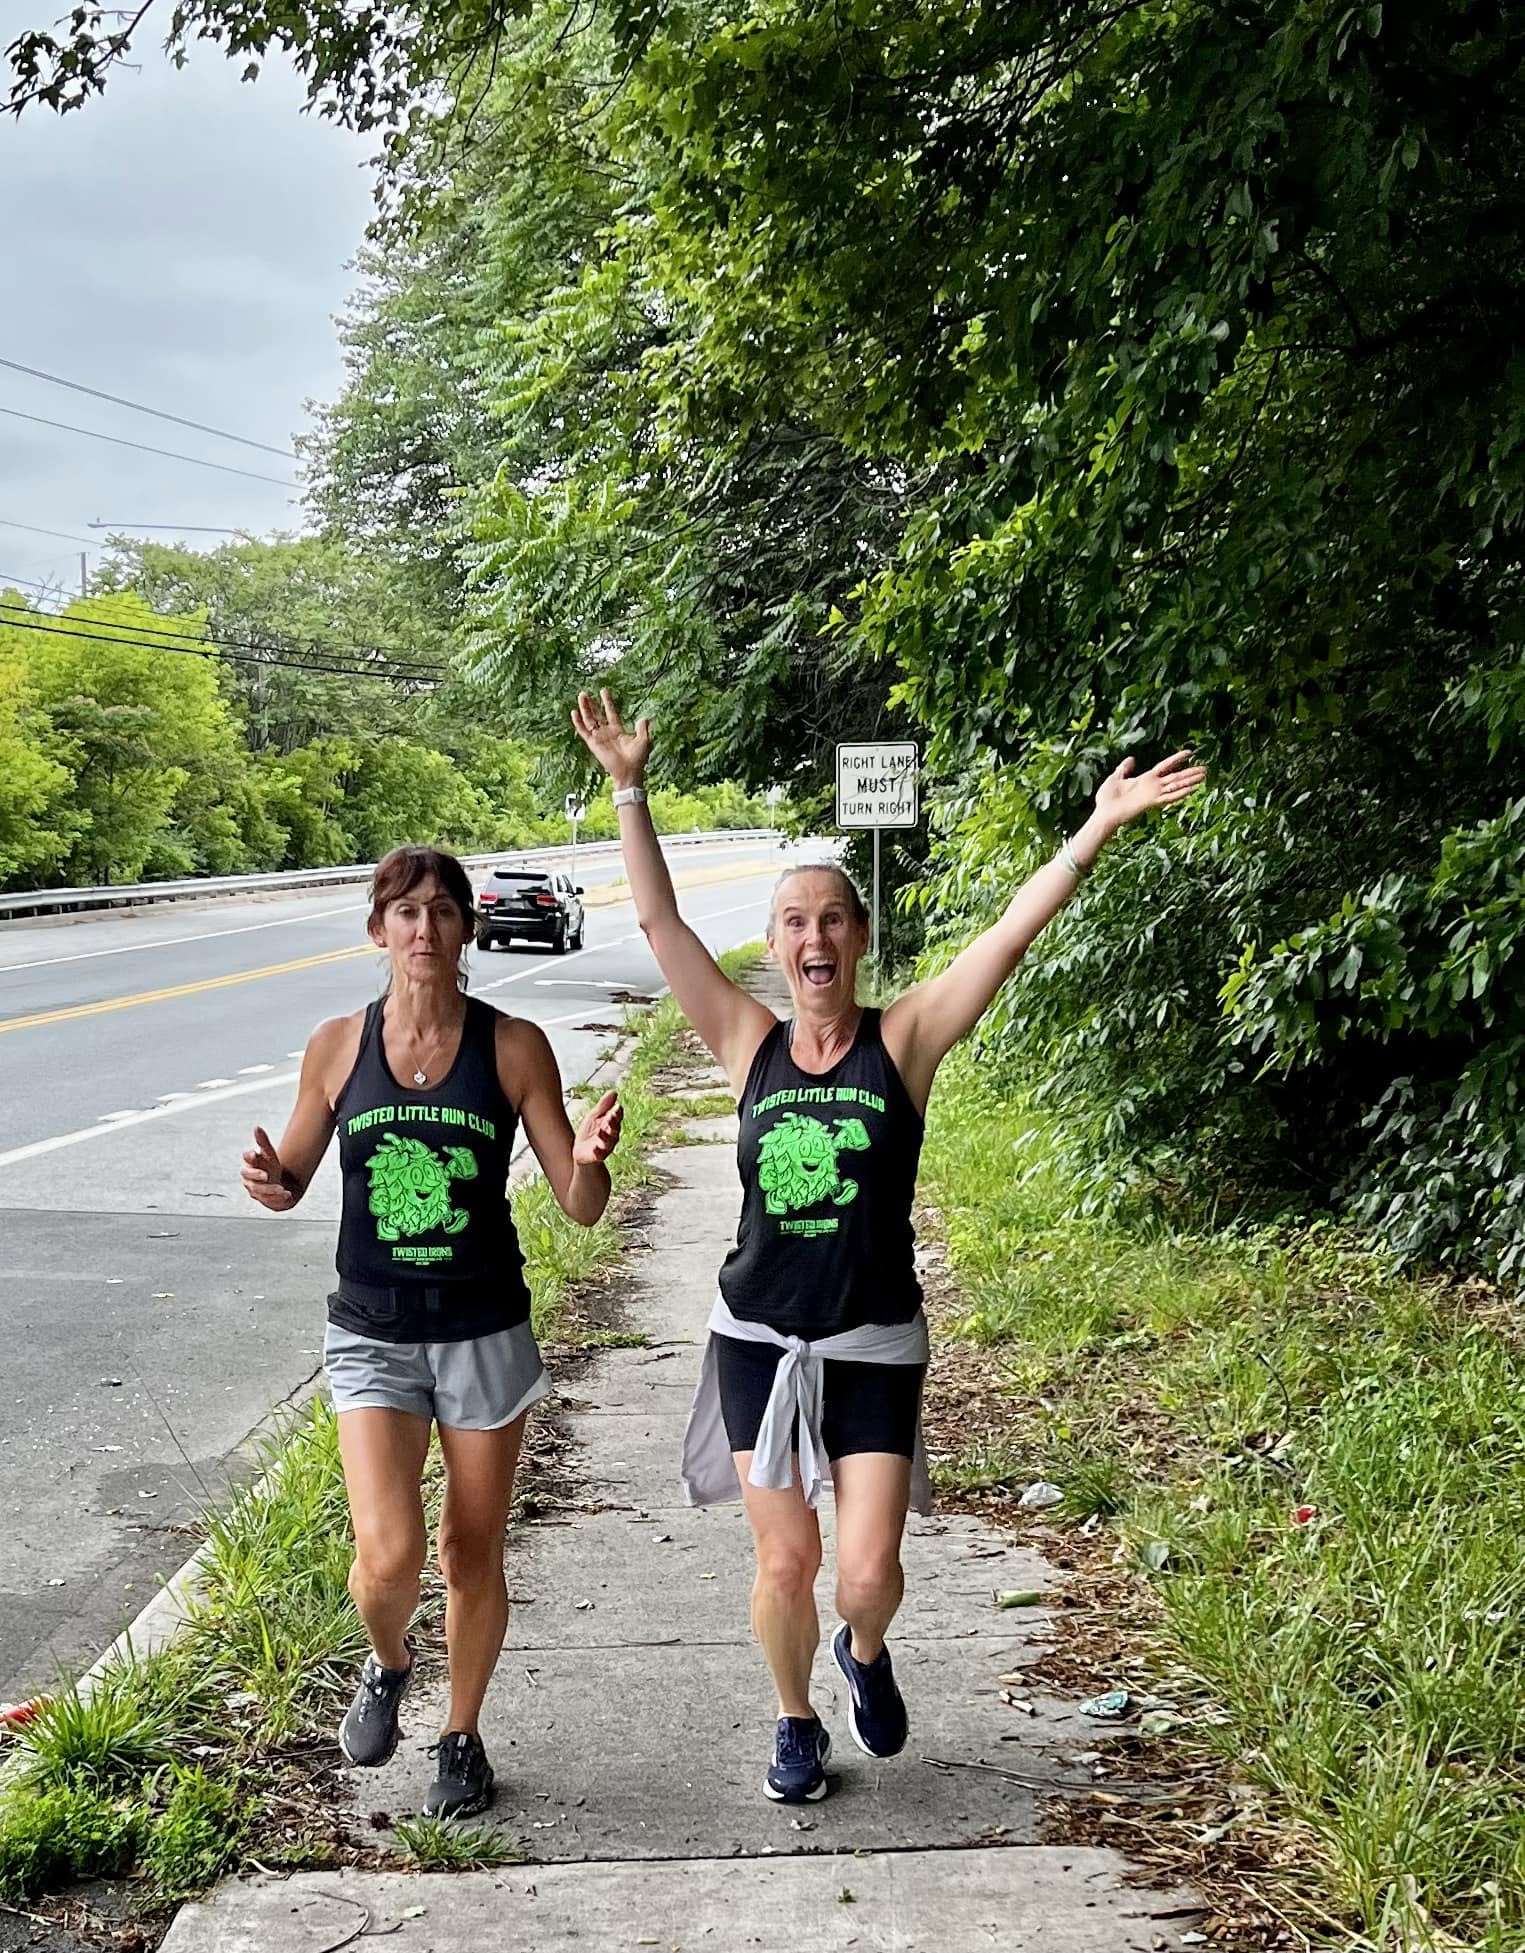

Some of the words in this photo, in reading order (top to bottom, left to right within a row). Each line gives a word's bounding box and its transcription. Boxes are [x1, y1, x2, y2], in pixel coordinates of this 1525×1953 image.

[842, 756, 875, 769] RIGHT
[881, 755, 912, 768] LANE
[857, 777, 896, 793] MUST
[842, 802, 872, 815] TURN
[879, 801, 912, 815] RIGHT
[752, 1089, 797, 1119] TWISTED
[797, 1087, 835, 1103] LITTLE
[835, 1087, 857, 1102] RUN
[858, 1089, 885, 1113] CLUB
[347, 1105, 395, 1136] TWISTED
[397, 1105, 440, 1121] LITTLE
[441, 1107, 465, 1127] RUN
[467, 1112, 496, 1140] CLUB
[392, 1247, 428, 1257] TWISTED
